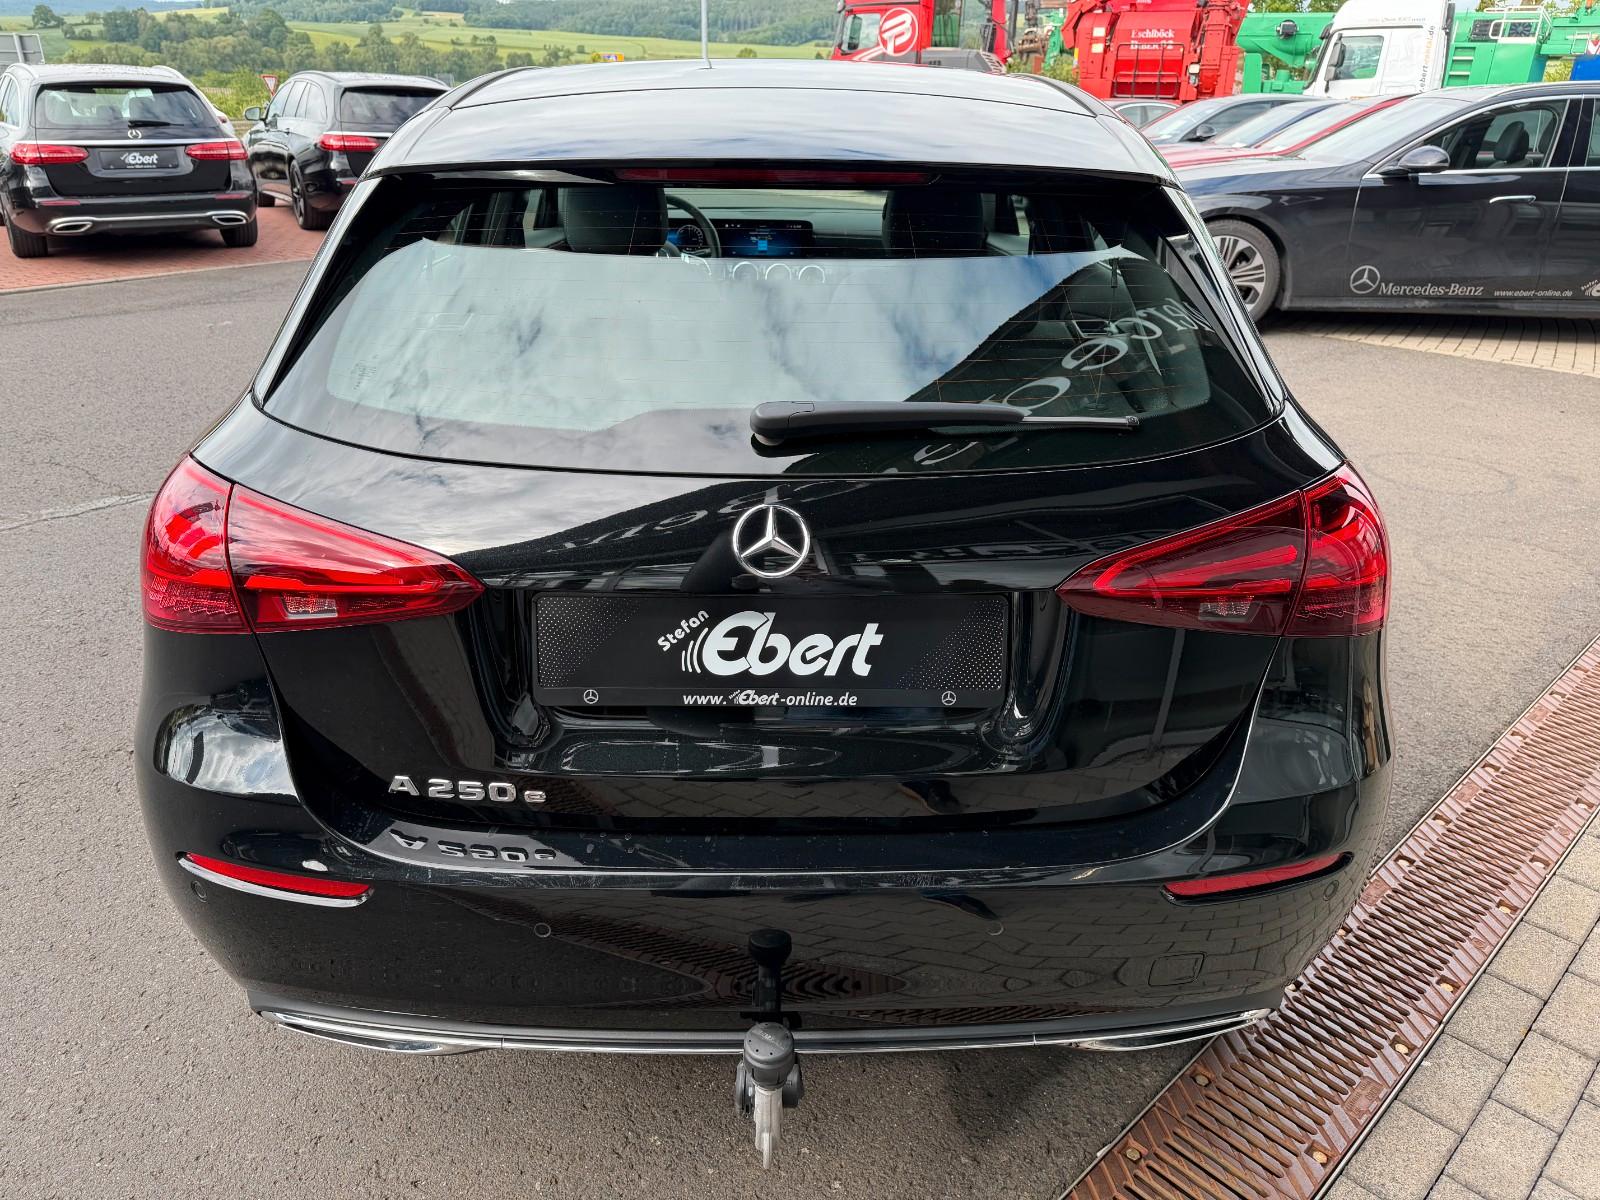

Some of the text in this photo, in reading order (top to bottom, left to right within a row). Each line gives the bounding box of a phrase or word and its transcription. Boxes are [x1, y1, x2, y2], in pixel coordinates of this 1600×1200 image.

[128, 152, 158, 164] Ebert
[1378, 282, 1484, 296] Mercedes-Benz
[1494, 289, 1573, 297] www.ebert-online.de
[657, 610, 710, 652] Stefan
[702, 610, 884, 677] Ebert
[388, 775, 420, 796] A
